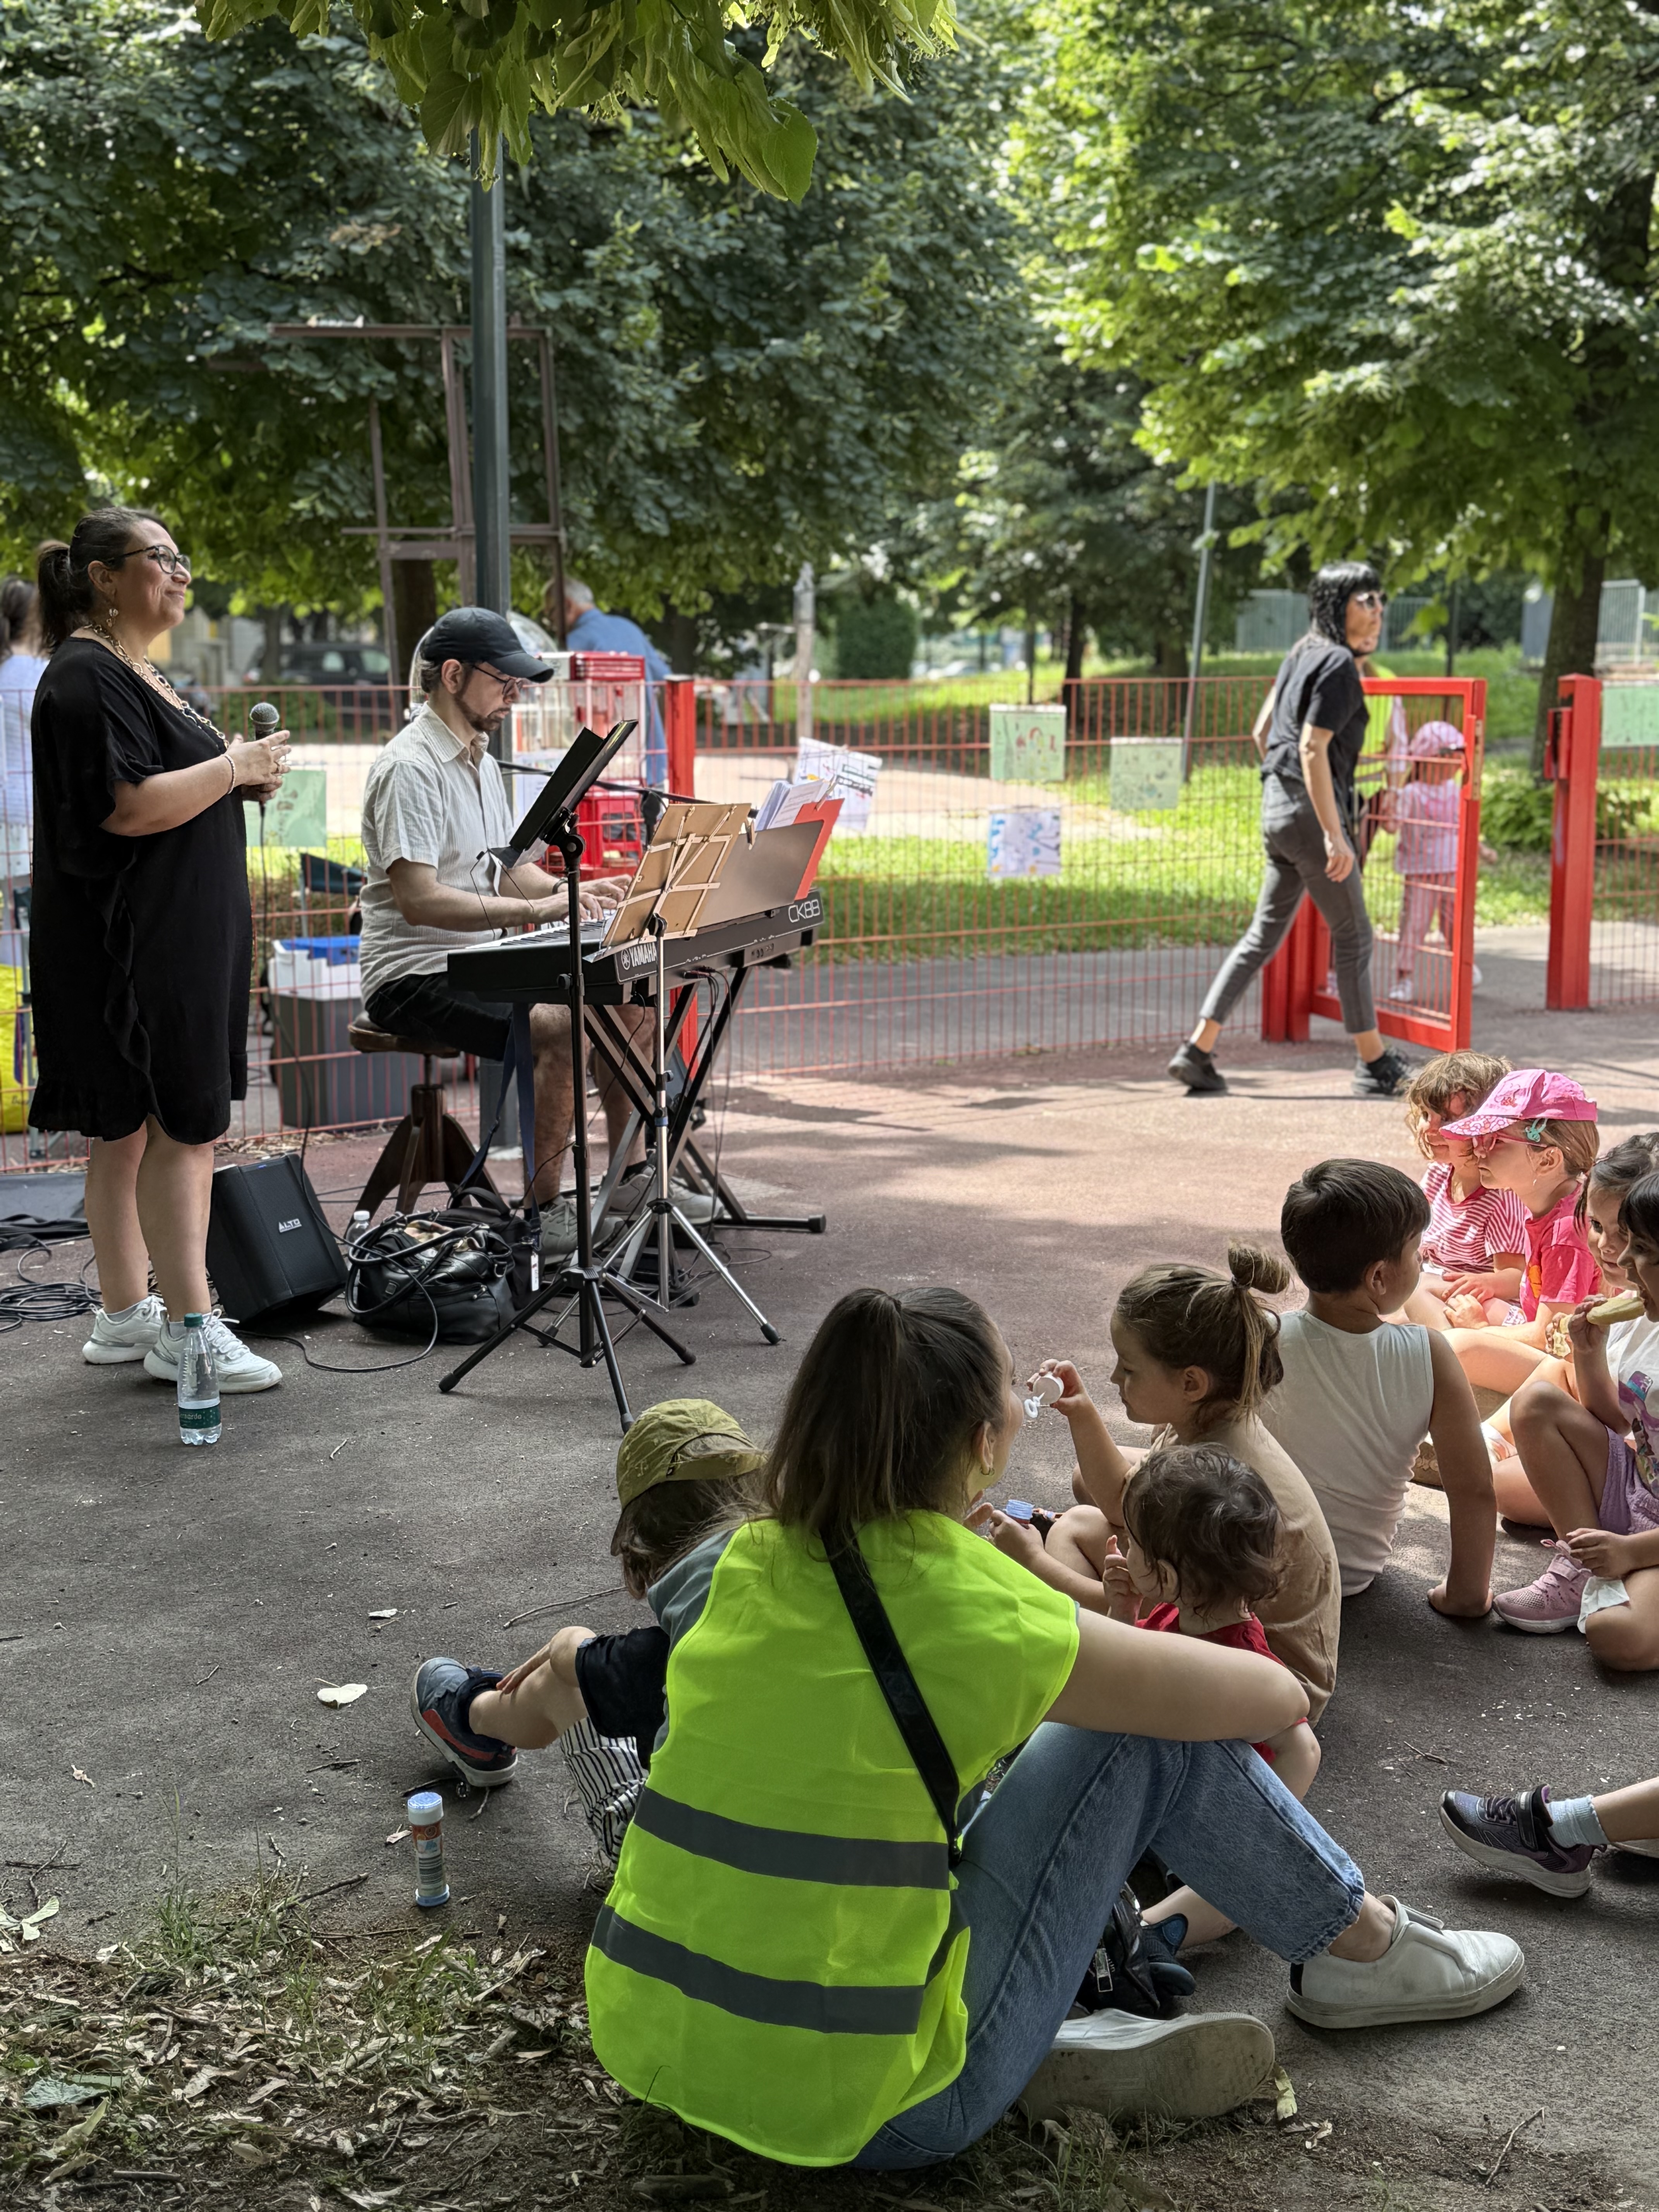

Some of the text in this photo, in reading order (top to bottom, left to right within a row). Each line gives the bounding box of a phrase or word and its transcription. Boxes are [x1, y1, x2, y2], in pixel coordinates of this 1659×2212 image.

[788, 899, 820, 923] CK88
[629, 942, 657, 967] YAMAHA
[278, 1218, 301, 1230] ALTO
